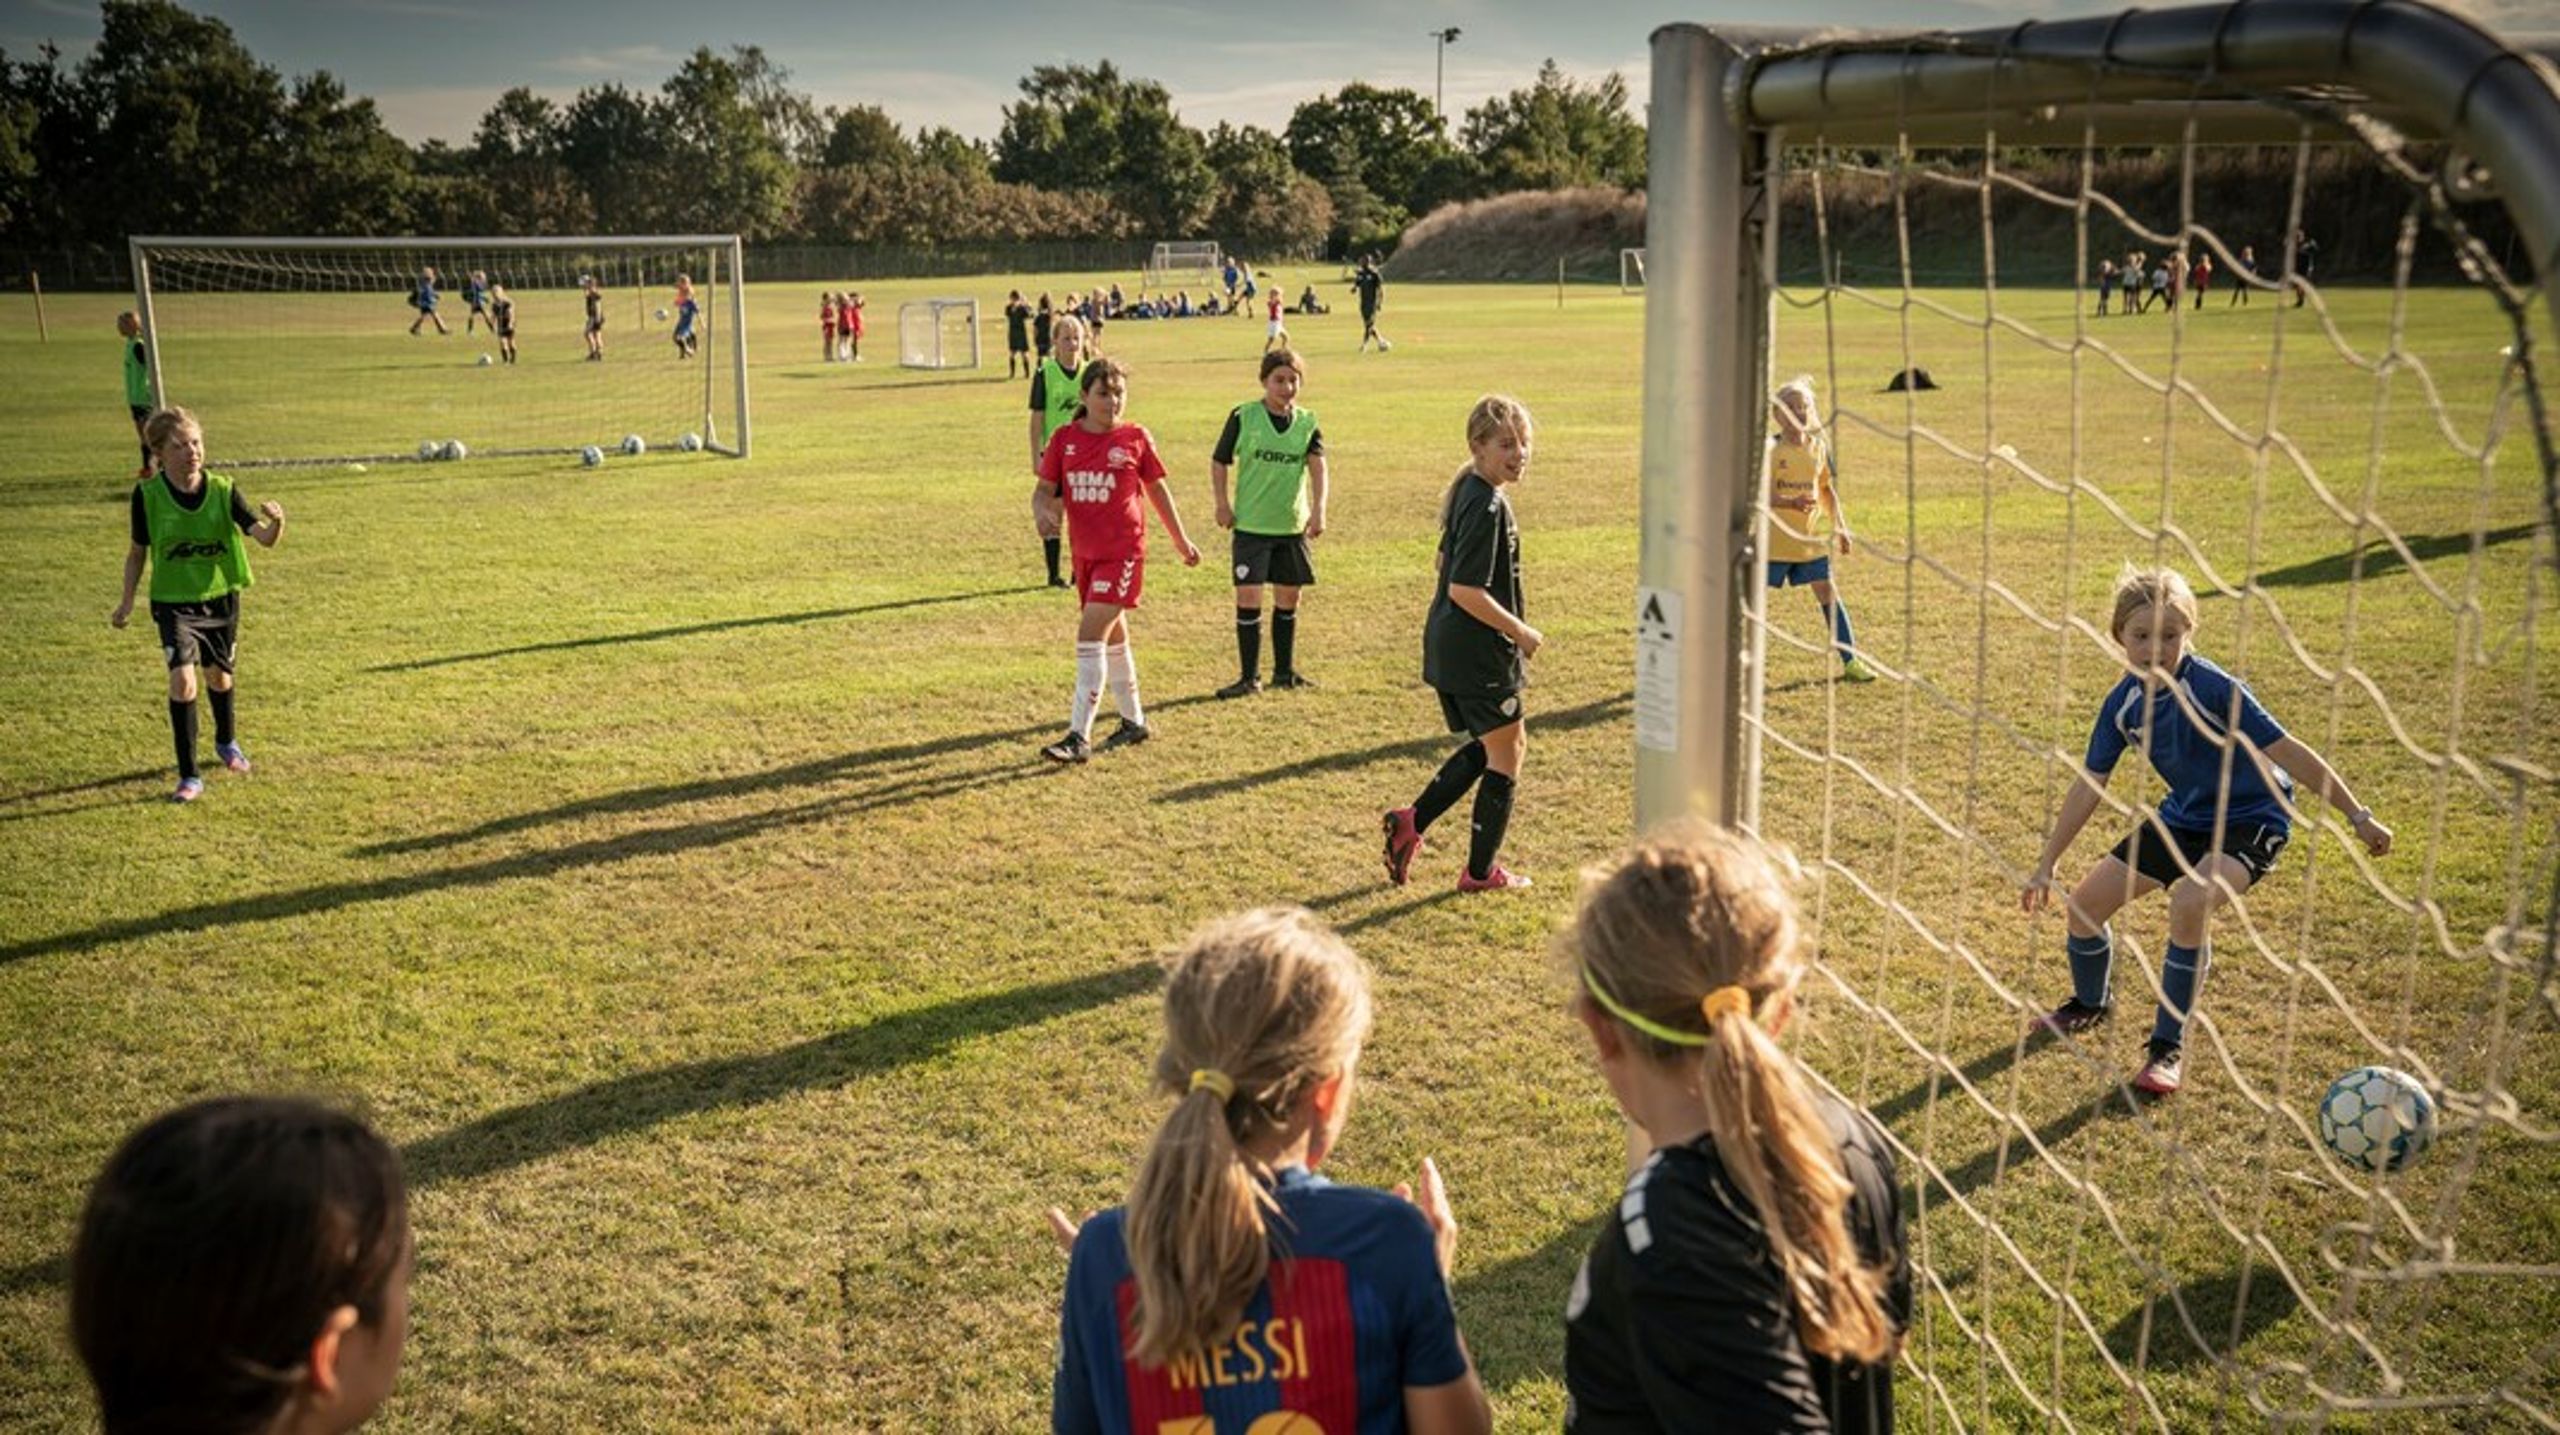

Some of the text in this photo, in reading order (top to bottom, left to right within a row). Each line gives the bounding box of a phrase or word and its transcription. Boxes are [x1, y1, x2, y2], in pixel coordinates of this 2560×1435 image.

[1066, 471, 1116, 490] REMA
[1071, 487, 1110, 503] 1000
[1169, 1316, 1309, 1390] MESSI
